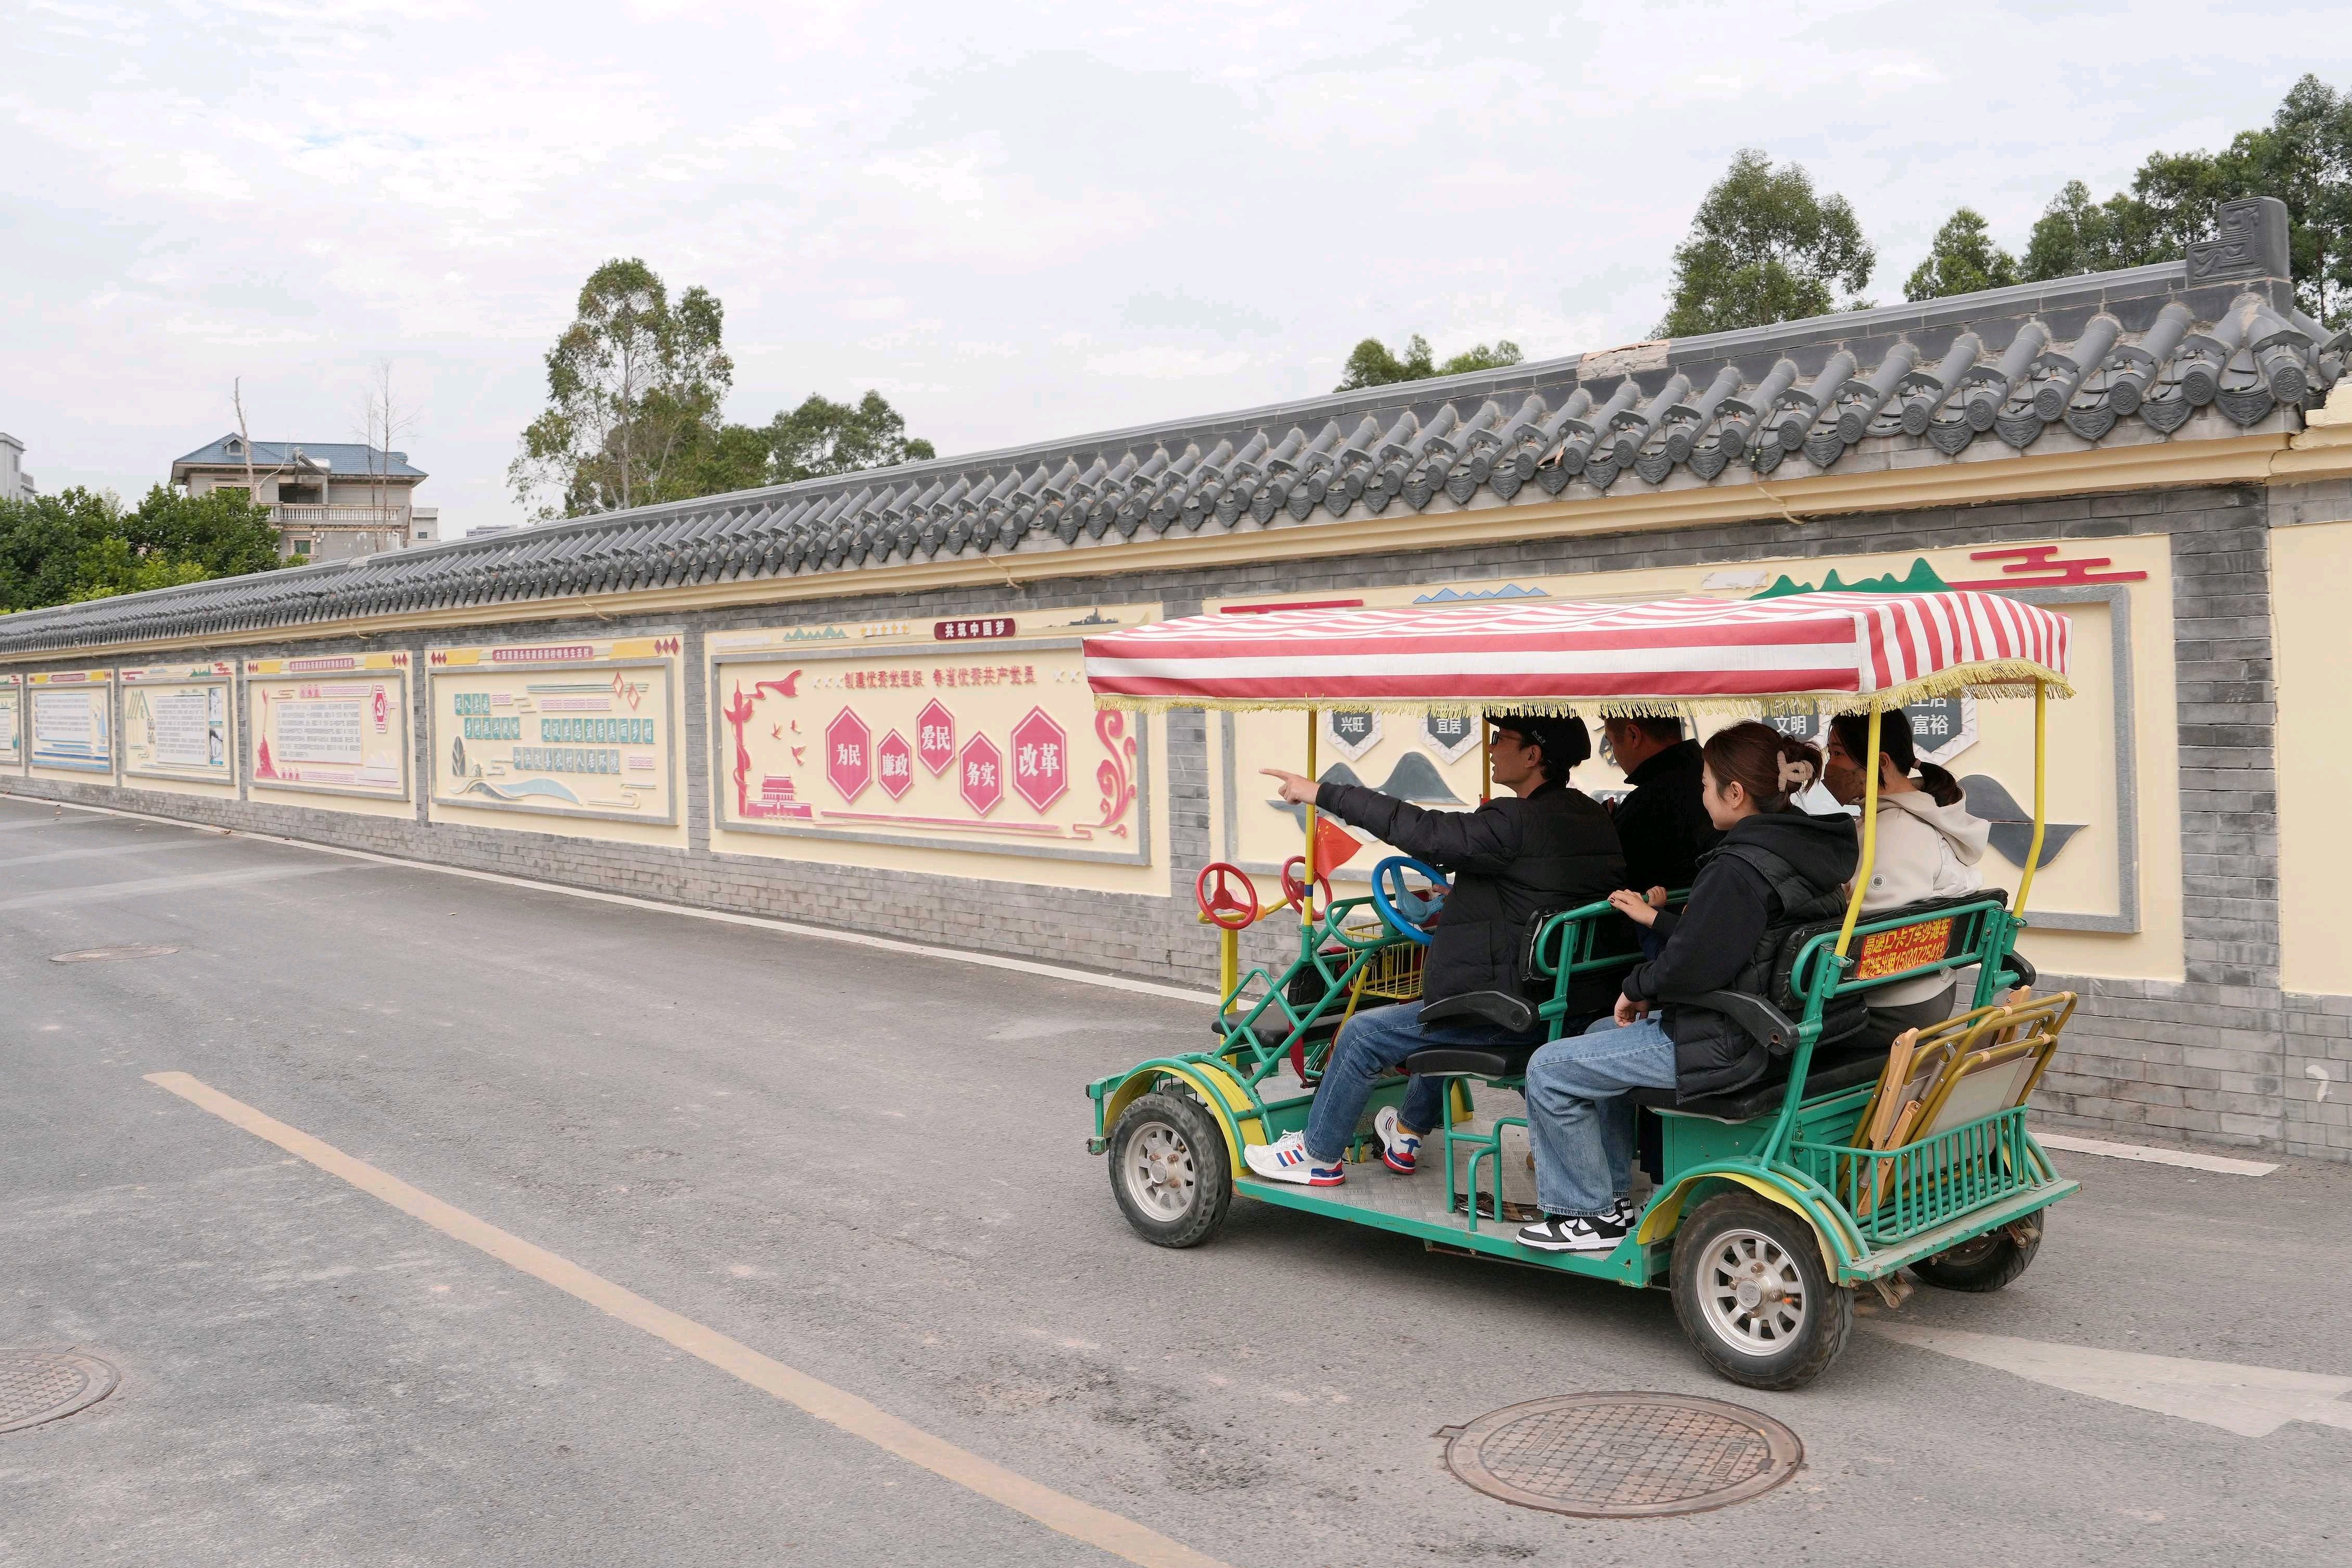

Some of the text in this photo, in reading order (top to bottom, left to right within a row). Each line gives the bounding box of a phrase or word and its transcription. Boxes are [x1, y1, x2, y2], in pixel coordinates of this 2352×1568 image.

[945, 621, 1005, 638] 共筑中国梦
[844, 665, 1037, 688] 创建优秀党组织 争当优秀共产党员
[541, 720, 652, 740] 建设生态宜居美丽乡村
[1341, 716, 1365, 733] 兴旺
[1436, 717, 1462, 734] 宜居
[1773, 715, 1807, 735] 文明
[1911, 714, 1949, 735] 富裕
[921, 724, 952, 751] 爱民
[513, 750, 619, 771] 加快改善农村人居环境
[836, 743, 862, 768] 为民
[881, 752, 909, 778] 廉政
[1018, 743, 1060, 778] 改革
[966, 761, 996, 788] 务实
[1863, 917, 1951, 956] 高速口卡丁车沙滩车
